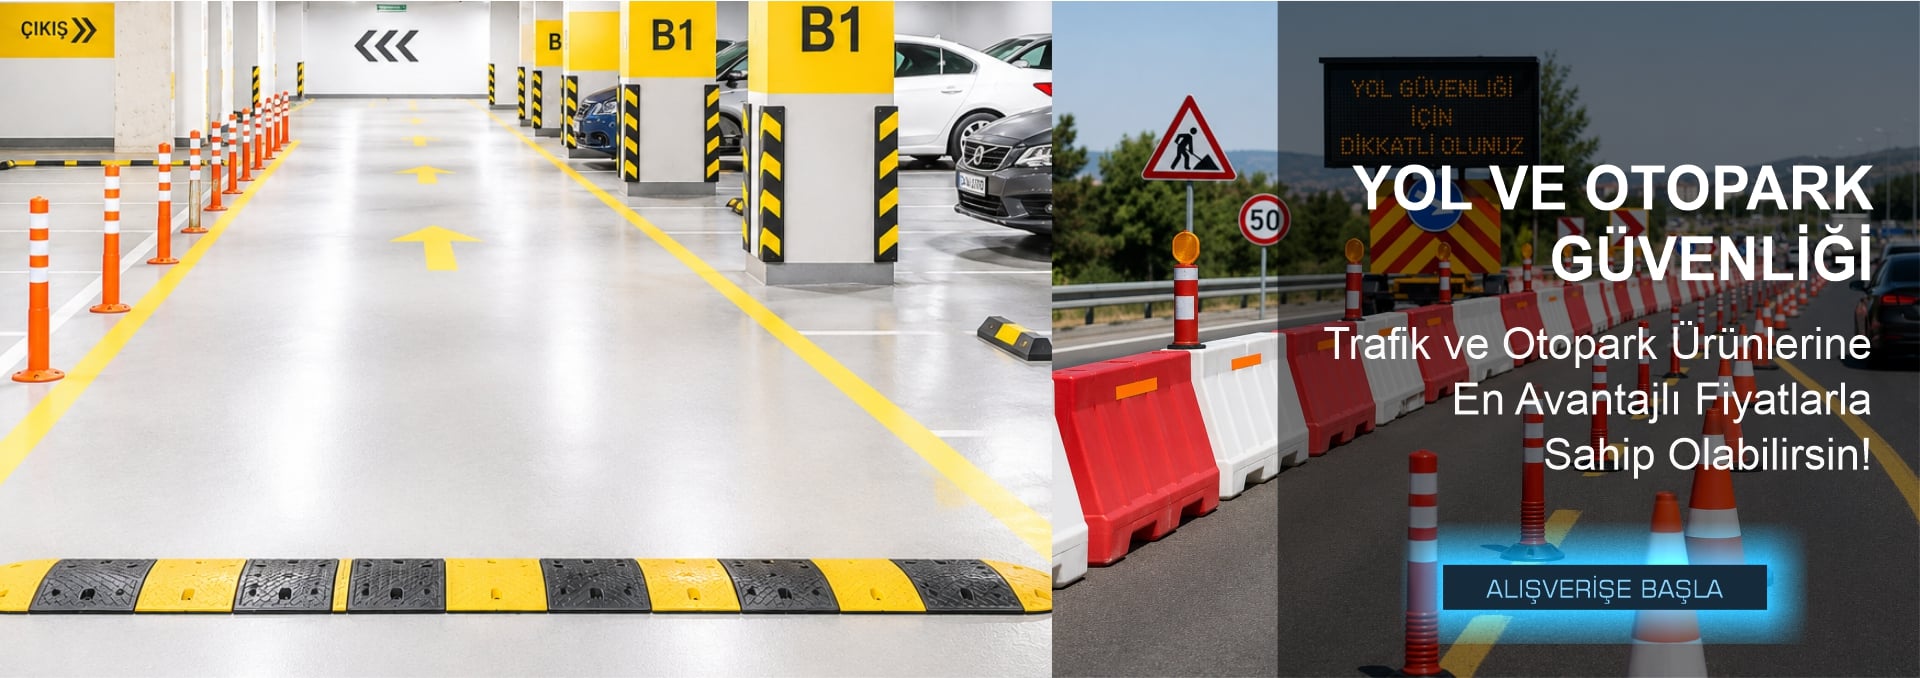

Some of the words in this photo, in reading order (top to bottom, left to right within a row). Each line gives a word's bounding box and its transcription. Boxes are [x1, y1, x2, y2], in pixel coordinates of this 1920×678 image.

[21, 21, 68, 39] ÇIKIŞ
[652, 19, 692, 51] B1
[801, 5, 859, 52] B1
[548, 33, 562, 51] B
[1351, 79, 1393, 98] YOL
[1411, 104, 1453, 130] İÇİN
[1340, 133, 1436, 155] DİKKATLİ
[1441, 136, 1525, 155] OLUNUZ
[1250, 208, 1280, 231] 50
